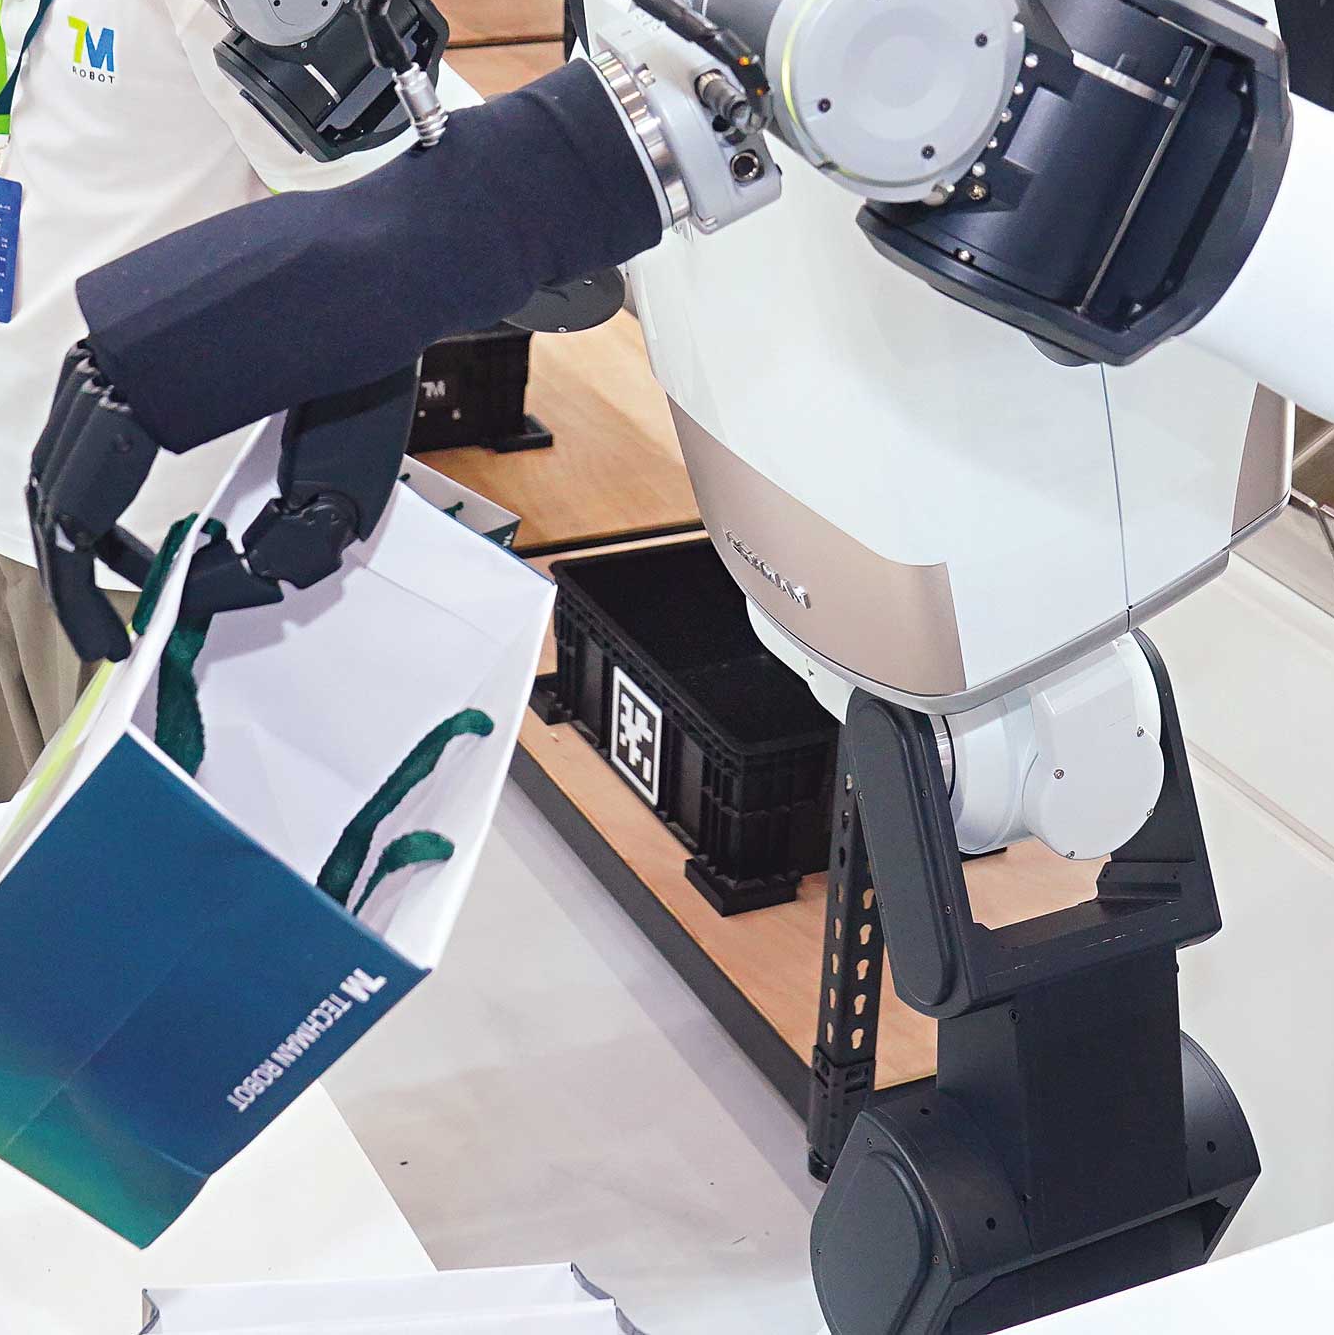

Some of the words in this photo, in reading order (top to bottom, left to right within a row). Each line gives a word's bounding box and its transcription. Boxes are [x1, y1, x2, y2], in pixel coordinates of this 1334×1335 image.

[67, 15, 115, 74] TM
[72, 65, 116, 84] ROBOT
[338, 966, 389, 1004] TM
[270, 992, 354, 1068] TECHMAN
[225, 1057, 285, 1113] ROBOT
